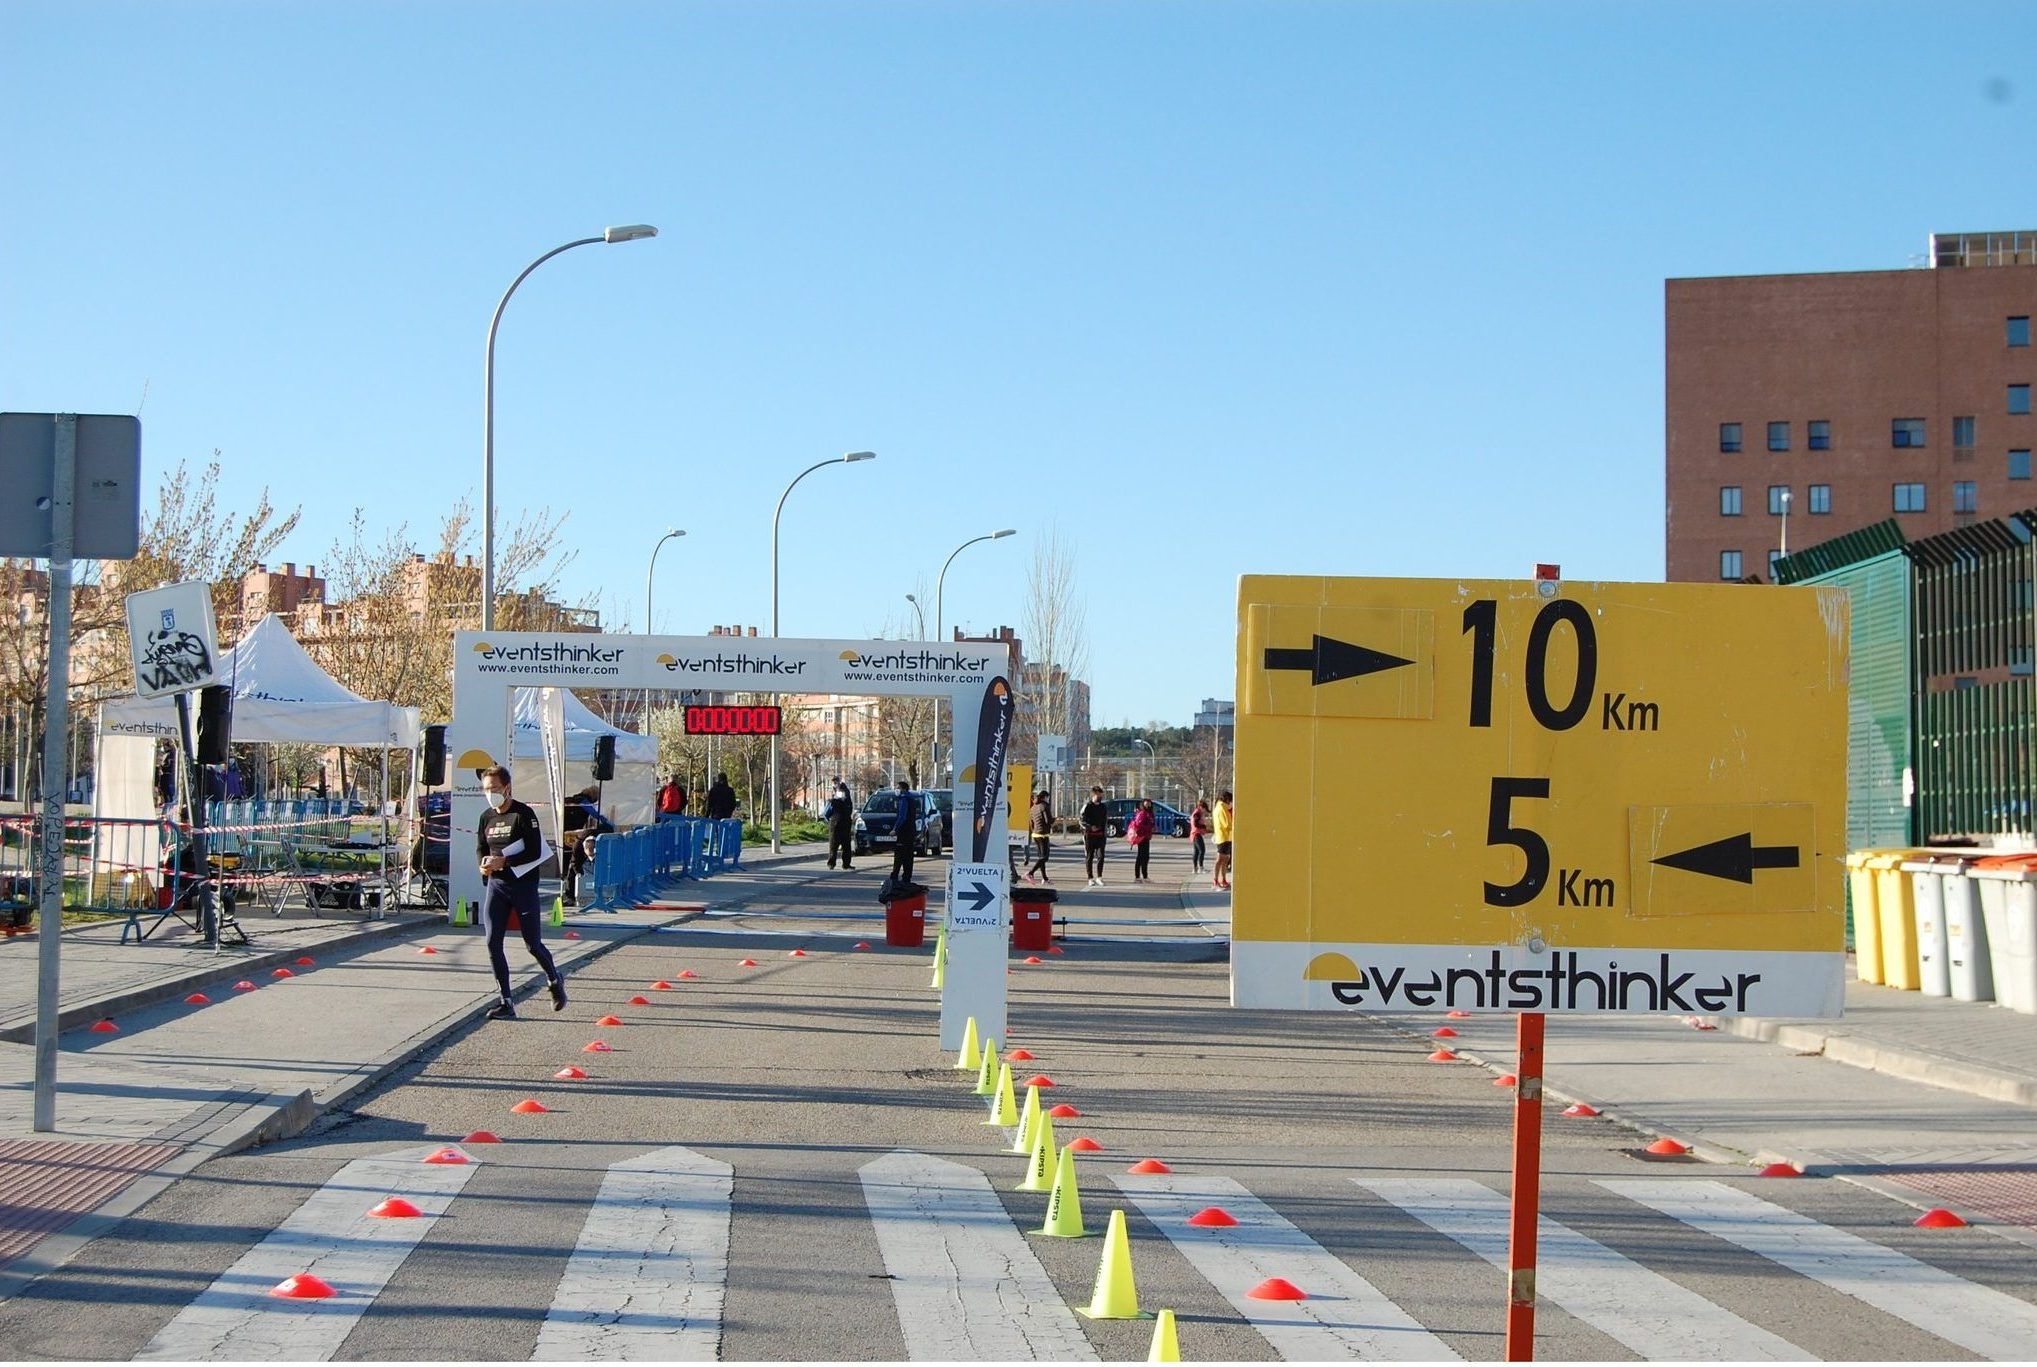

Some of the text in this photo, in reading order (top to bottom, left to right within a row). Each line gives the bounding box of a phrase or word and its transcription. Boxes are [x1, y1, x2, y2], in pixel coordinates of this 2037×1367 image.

[482, 641, 625, 662] eventsthinker
[848, 649, 989, 671] eventsthinker
[478, 663, 619, 675] www.eventsthinker.com
[666, 653, 806, 674] eventsthinker
[1462, 599, 1659, 731] 10 Km
[844, 672, 984, 684] www.eventsthinker.com
[111, 722, 178, 736] eventsthin
[1483, 777, 1615, 908] 5 Km
[1332, 950, 1761, 1012] eventsthinker
